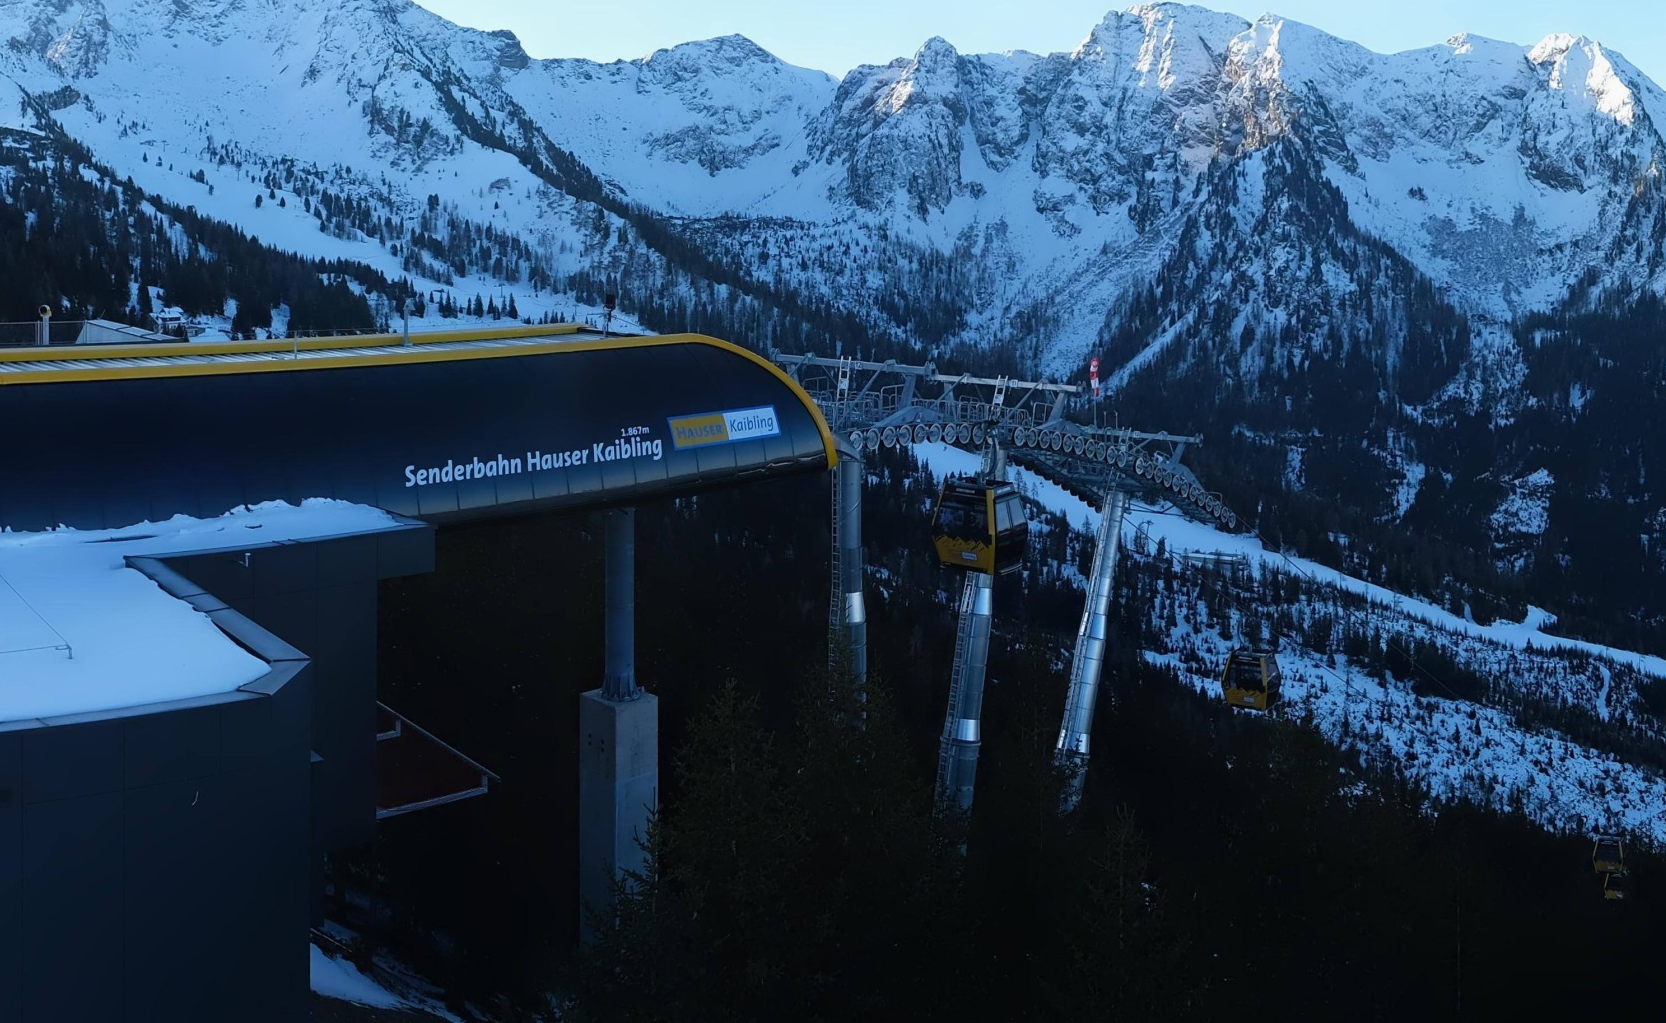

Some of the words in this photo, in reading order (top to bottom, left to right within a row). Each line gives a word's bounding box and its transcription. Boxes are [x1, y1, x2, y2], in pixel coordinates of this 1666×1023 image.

[620, 425, 650, 437] 1.867m
[675, 423, 724, 440] HAUSER
[729, 414, 775, 434] Kaibling
[404, 454, 522, 487] Senderbahn
[527, 445, 590, 473] Hauser
[592, 436, 663, 462] Kaibling
